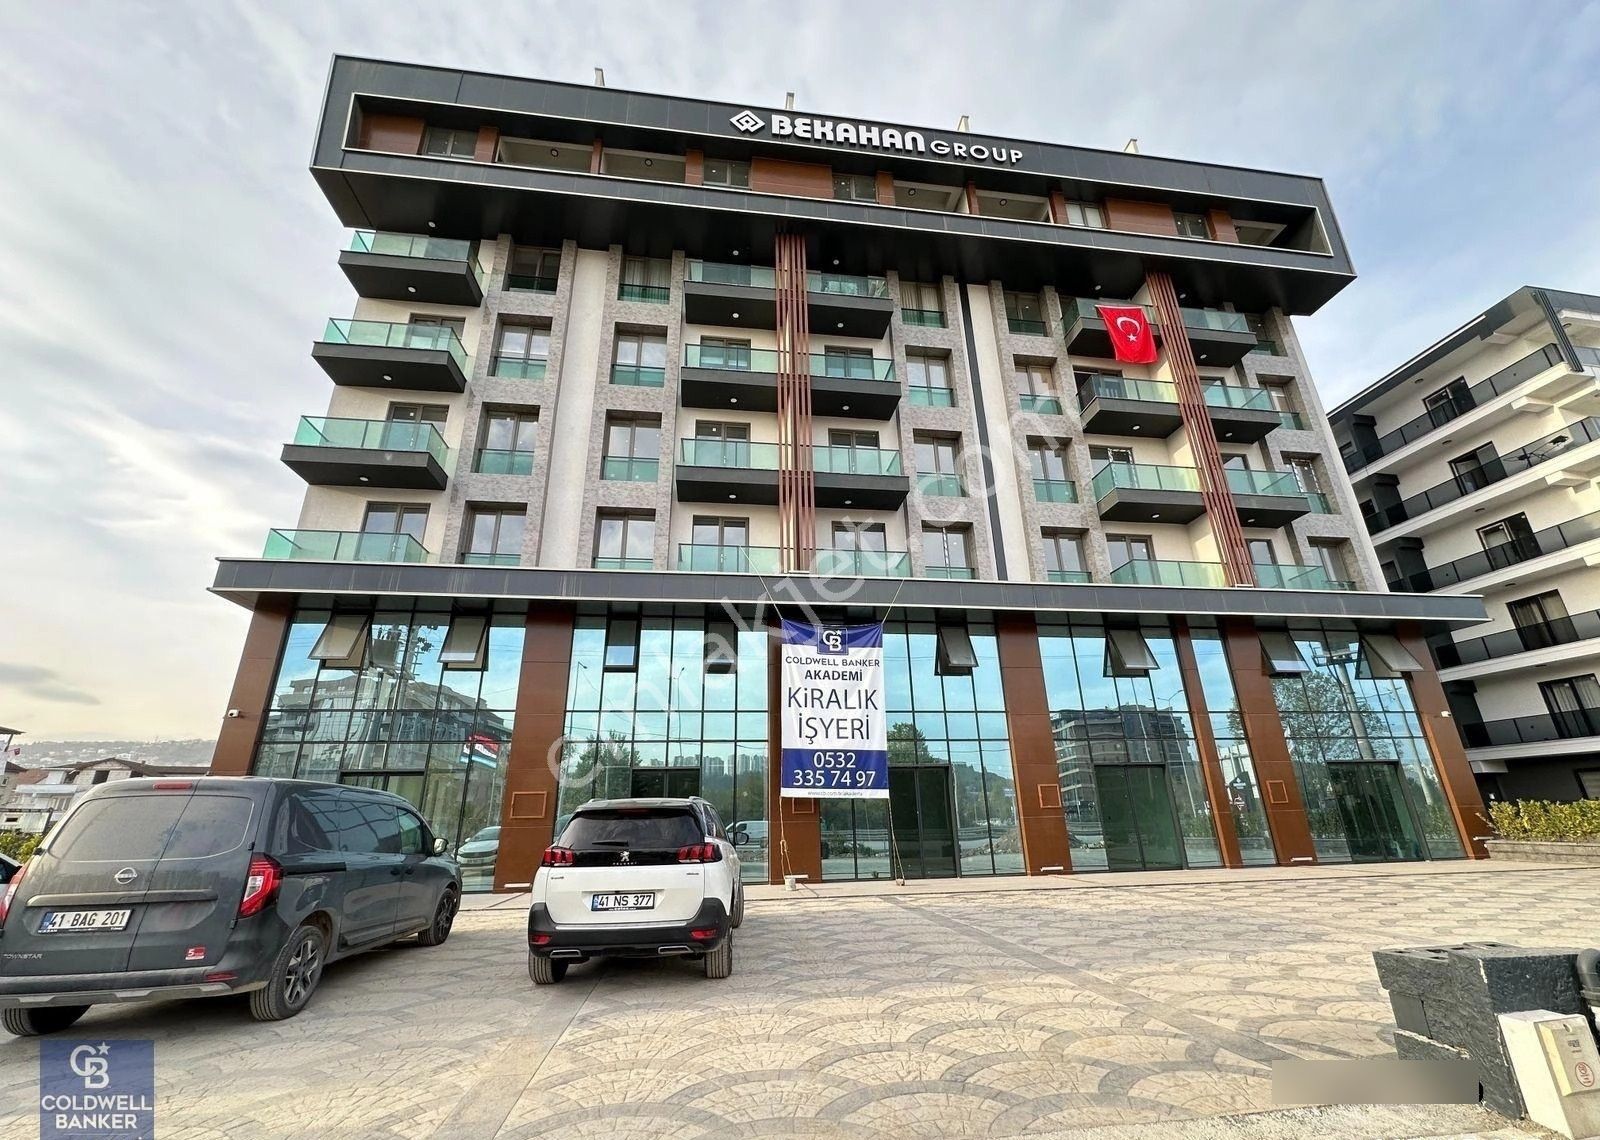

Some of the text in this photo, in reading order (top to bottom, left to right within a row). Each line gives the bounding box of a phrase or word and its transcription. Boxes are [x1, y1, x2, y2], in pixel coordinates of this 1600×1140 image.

[771, 114, 1023, 164] BEKAHAN GROUP
[785, 656, 880, 667] COLDWELL BANKER
[804, 669, 863, 682] AKADEMİ
[798, 713, 870, 745] İŞYERİ
[813, 751, 856, 768] 0532
[793, 769, 876, 787] 335 74 97
[598, 895, 652, 906] 41 NS 377
[49, 911, 126, 929] 41 BAG 201
